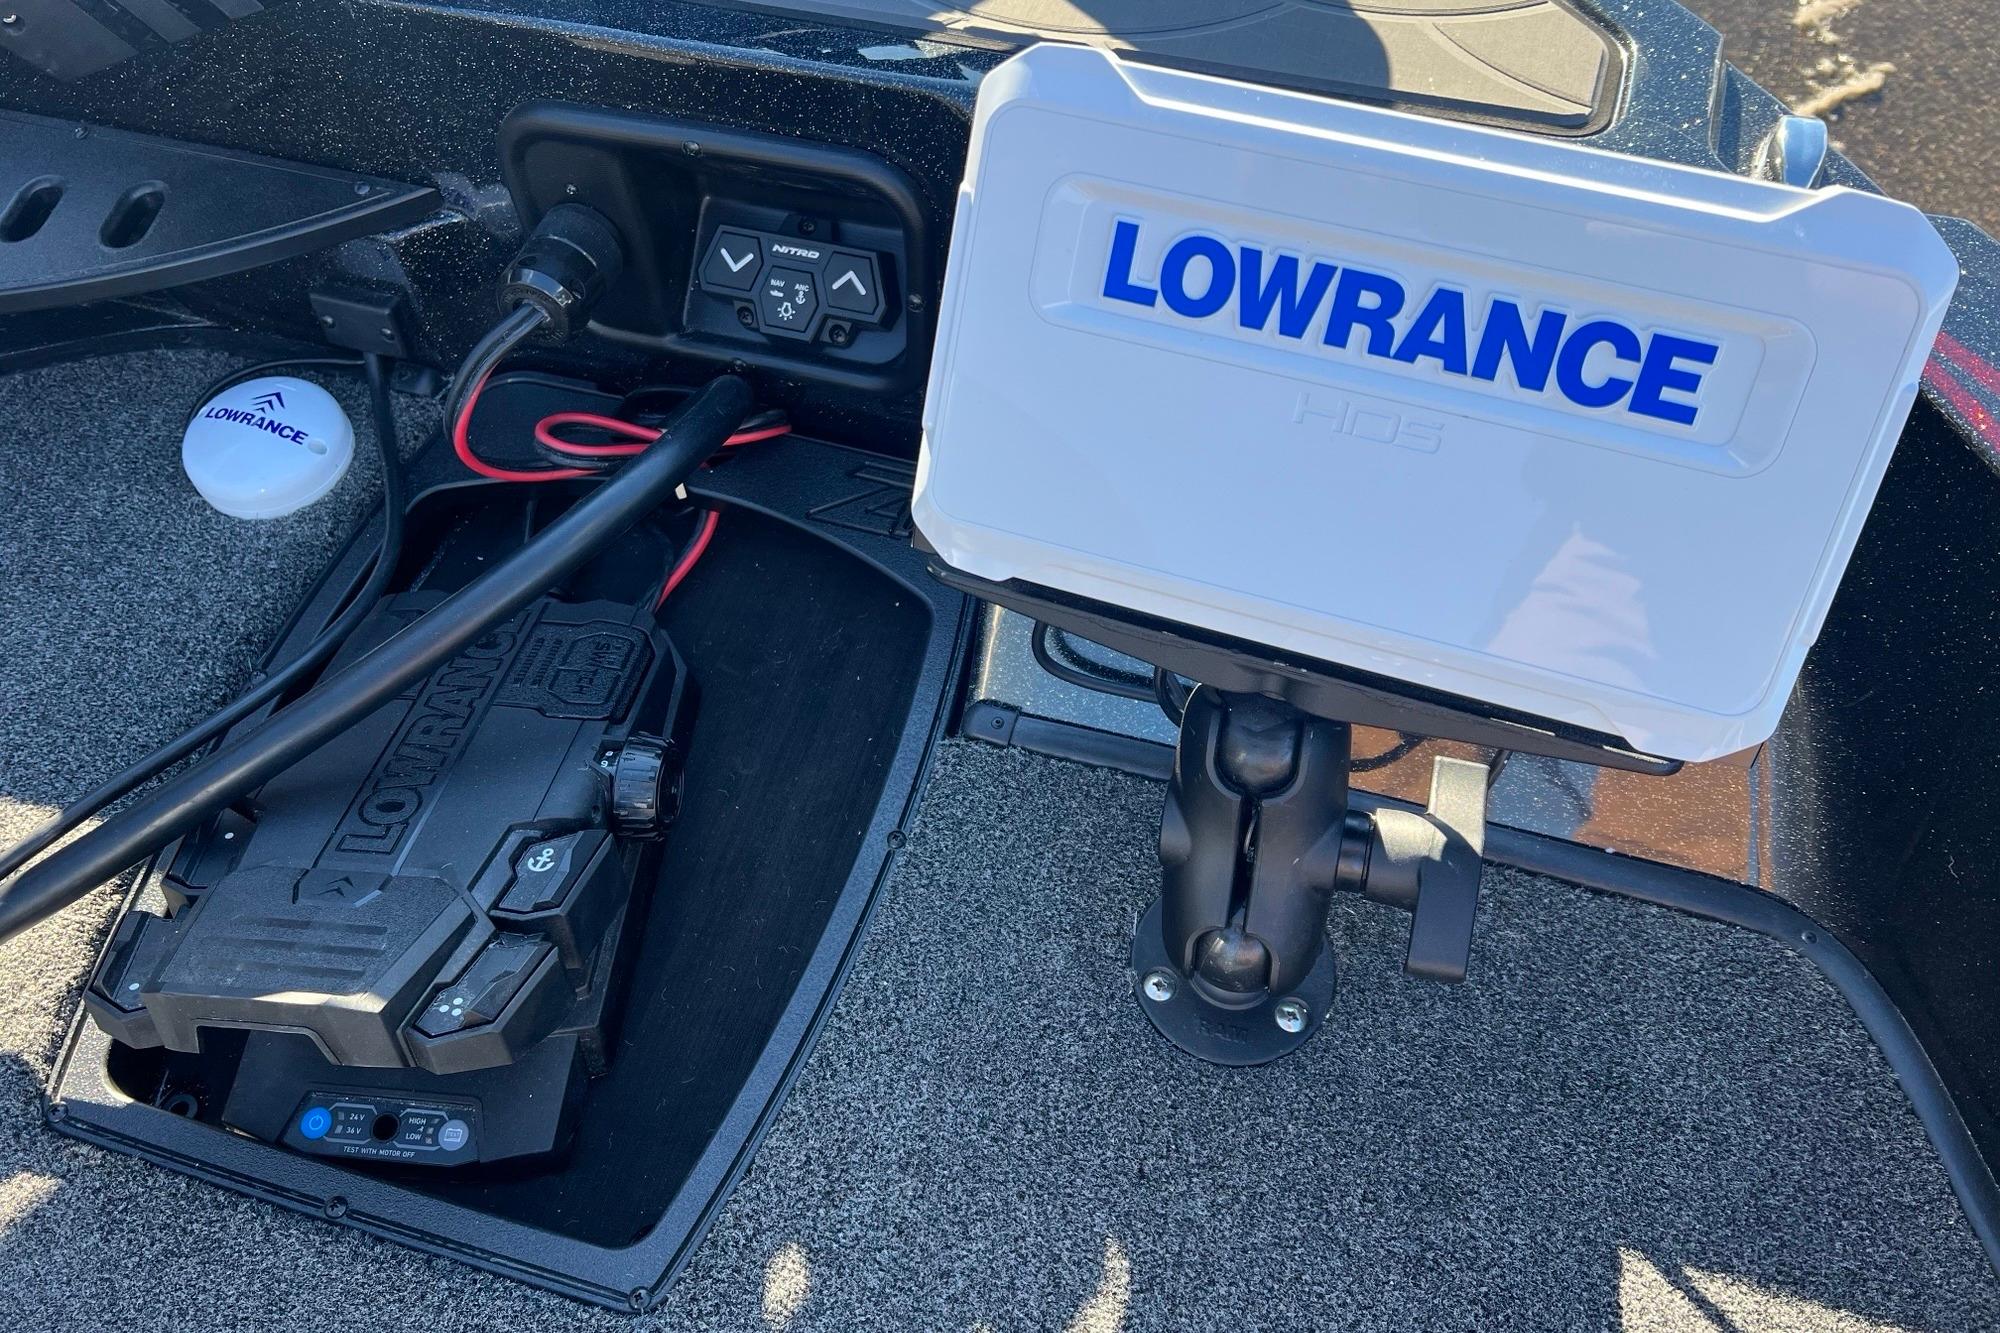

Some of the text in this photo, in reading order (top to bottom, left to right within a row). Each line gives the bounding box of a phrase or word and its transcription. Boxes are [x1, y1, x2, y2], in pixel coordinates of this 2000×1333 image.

[772, 244, 820, 259] NITRO
[770, 279, 785, 287] NAV
[794, 283, 809, 292] ANC
[1104, 220, 1718, 425] LOWRANCE
[205, 407, 309, 446] LOWRANCE
[1292, 391, 1446, 455] HDS
[349, 1112, 366, 1121] 24 V
[408, 1117, 427, 1125] HIGH
[346, 1126, 362, 1135] 36 V
[405, 1133, 422, 1141] LOW
[343, 1145, 359, 1153] TEST
[361, 1147, 378, 1155] WITH
[379, 1149, 401, 1157] MOTOR
